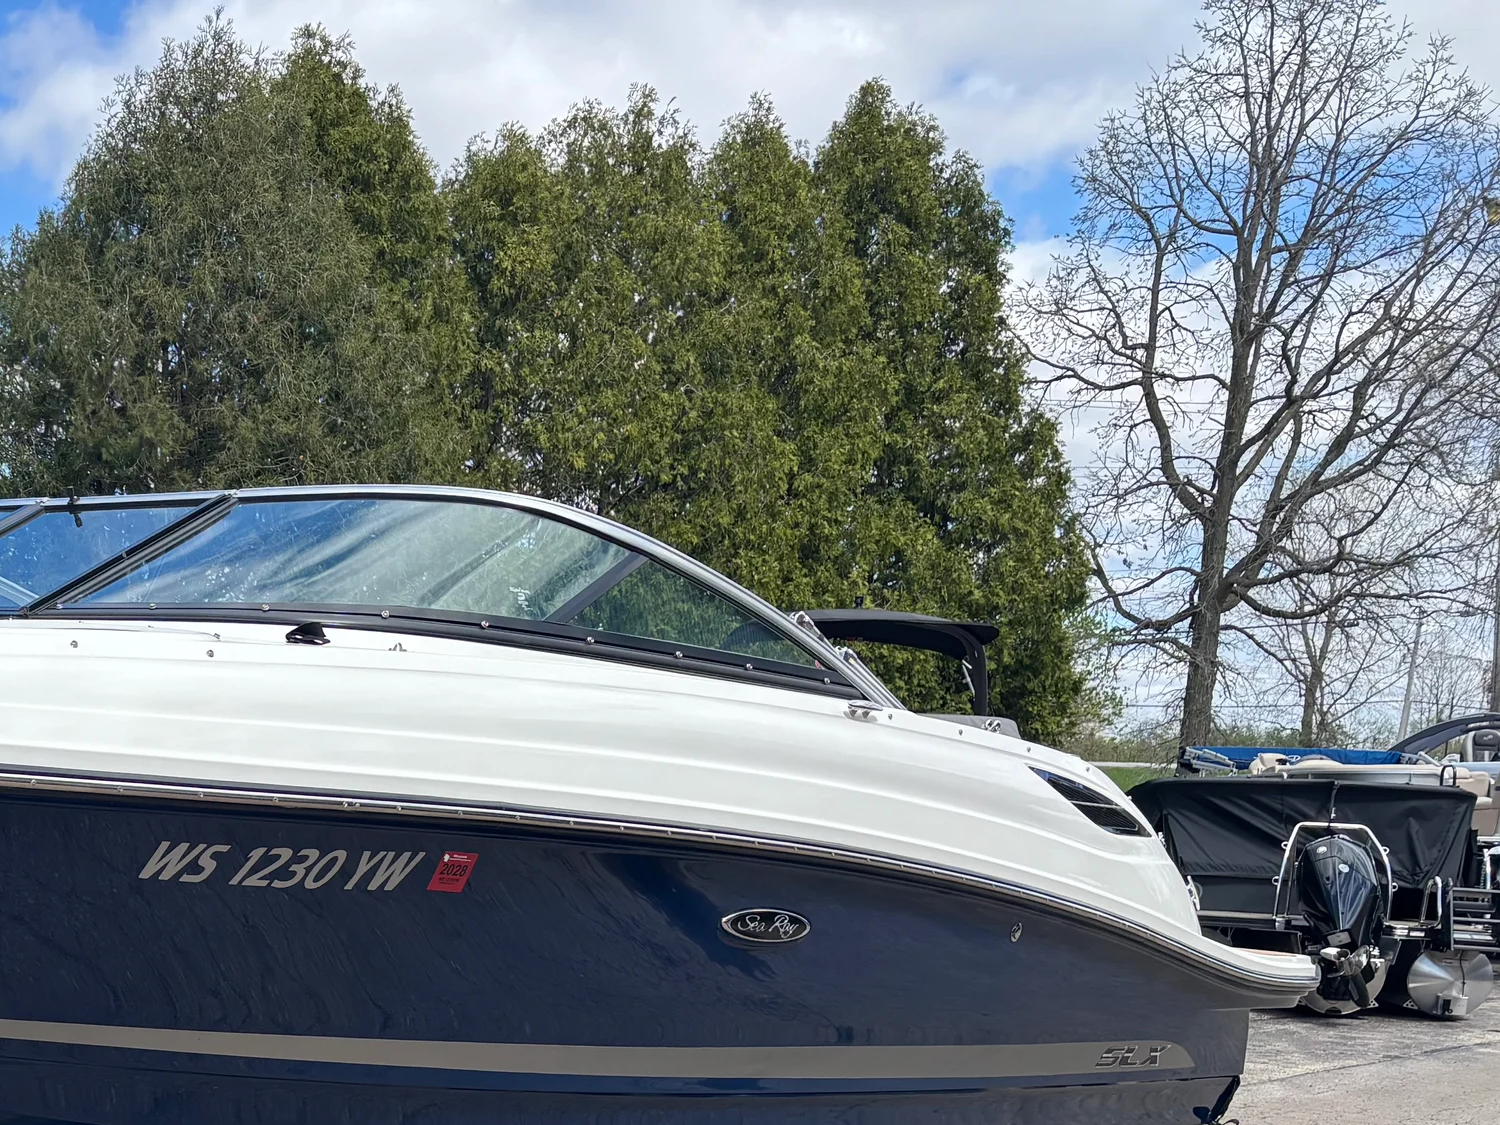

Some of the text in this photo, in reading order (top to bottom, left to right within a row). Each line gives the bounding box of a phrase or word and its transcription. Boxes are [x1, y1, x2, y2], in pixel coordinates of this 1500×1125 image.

[138, 840, 427, 891] WS 1230 YW
[439, 863, 468, 877] 2028
[737, 914, 799, 938] Sea Ray
[1095, 1045, 1172, 1069] SLX
